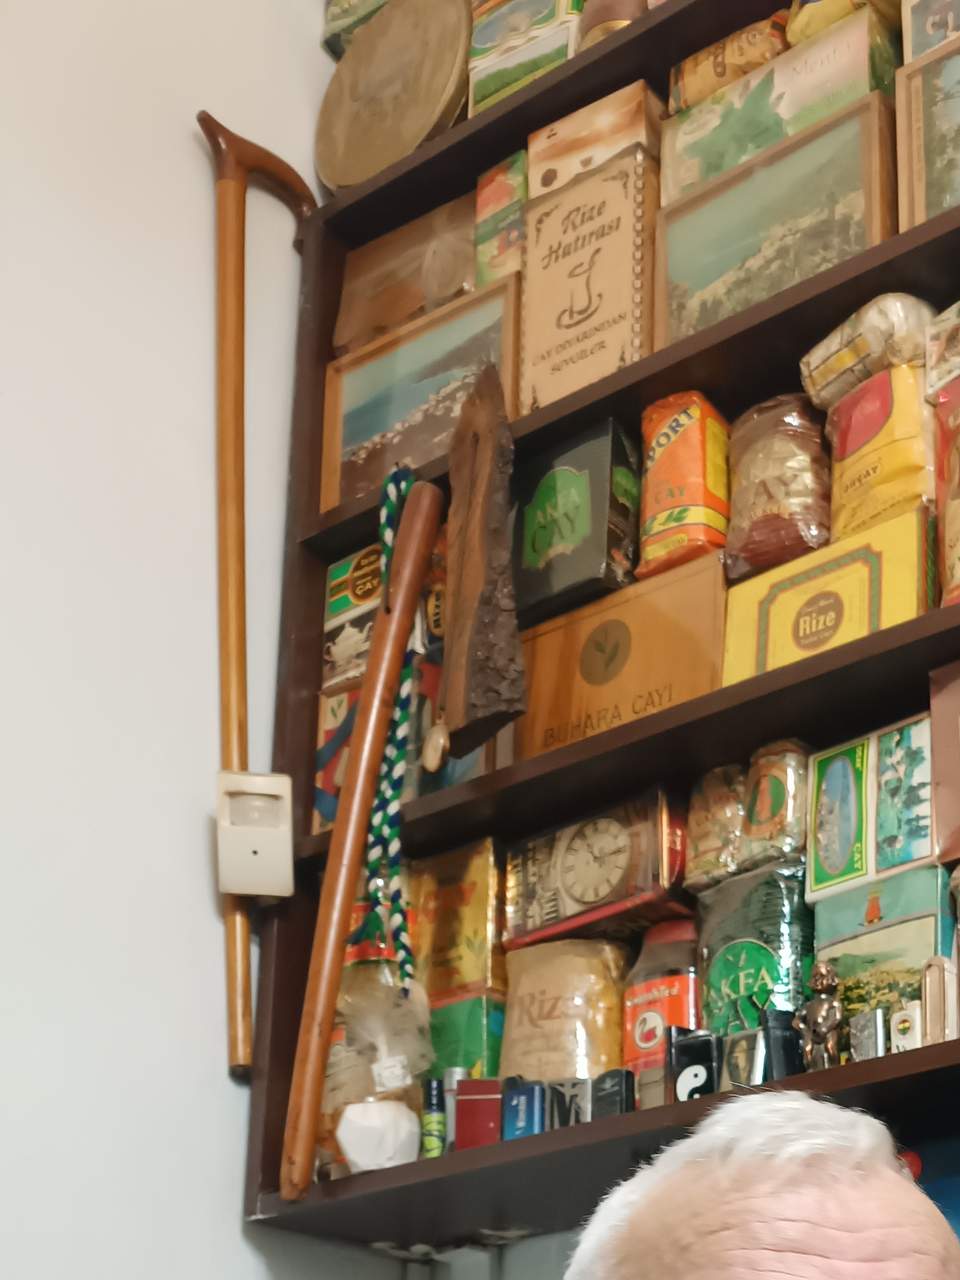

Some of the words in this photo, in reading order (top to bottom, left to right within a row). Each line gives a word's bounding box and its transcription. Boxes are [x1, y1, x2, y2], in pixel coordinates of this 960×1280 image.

[561, 200, 607, 236] Rize
[799, 610, 837, 638] Rize
[543, 703, 623, 749] BUHARA
